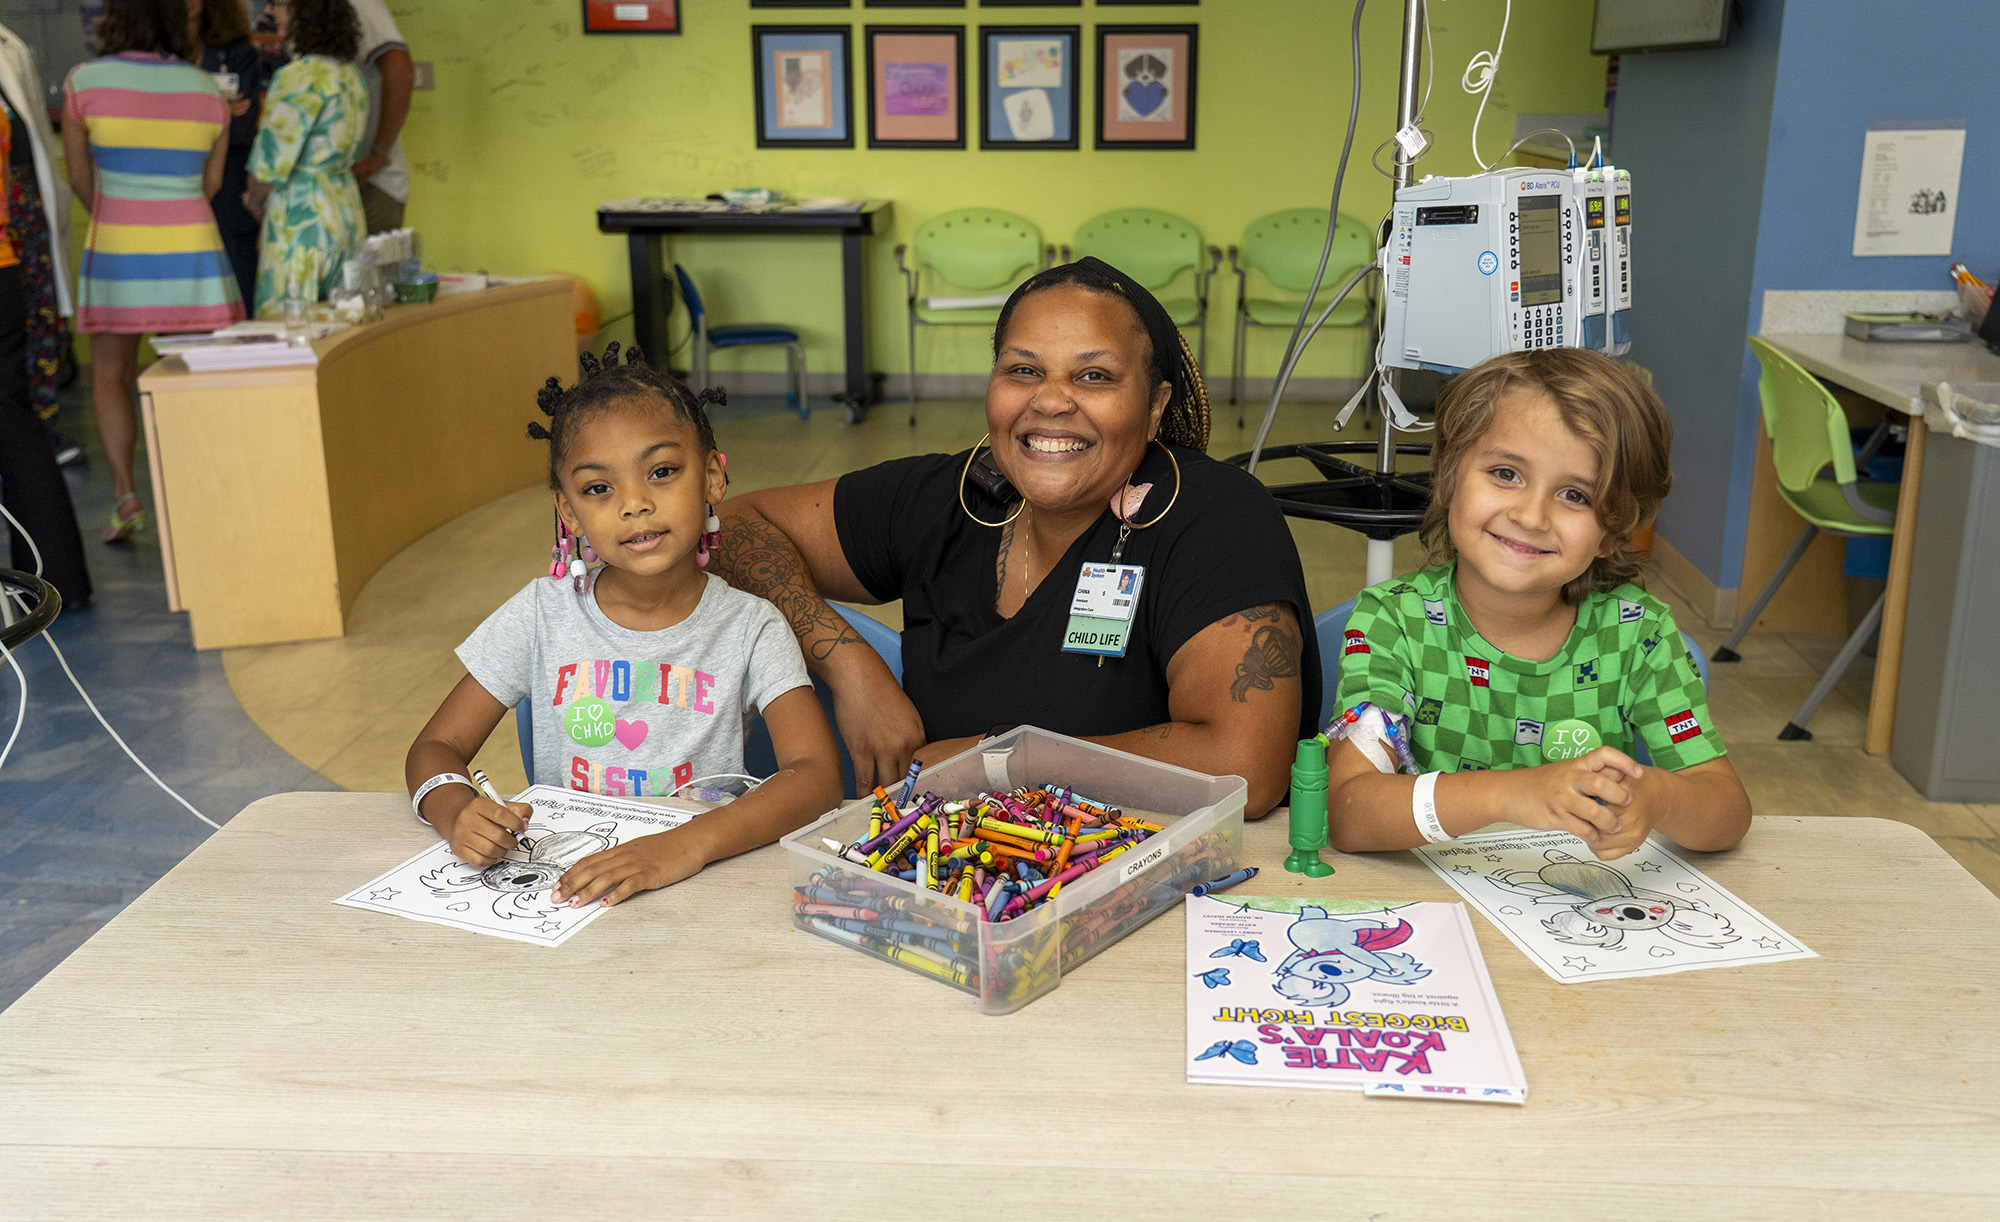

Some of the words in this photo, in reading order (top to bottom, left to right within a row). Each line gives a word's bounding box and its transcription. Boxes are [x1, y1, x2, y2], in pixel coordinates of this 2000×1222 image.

[1526, 181, 1534, 190] BD
[1551, 181, 1560, 189] PCU
[1068, 631, 1098, 645] CHILD
[1099, 633, 1121, 647] LIFE
[552, 659, 716, 716] FAVORITE
[571, 706, 586, 722] I
[571, 721, 615, 740] CHKD
[1672, 720, 1693, 733] TNT
[1552, 729, 1570, 745] I
[1547, 746, 1596, 760] CHK
[570, 755, 696, 798] SISTER
[1127, 848, 1162, 875] CRAYONS
[1257, 1023, 1447, 1052] KOALA'S
